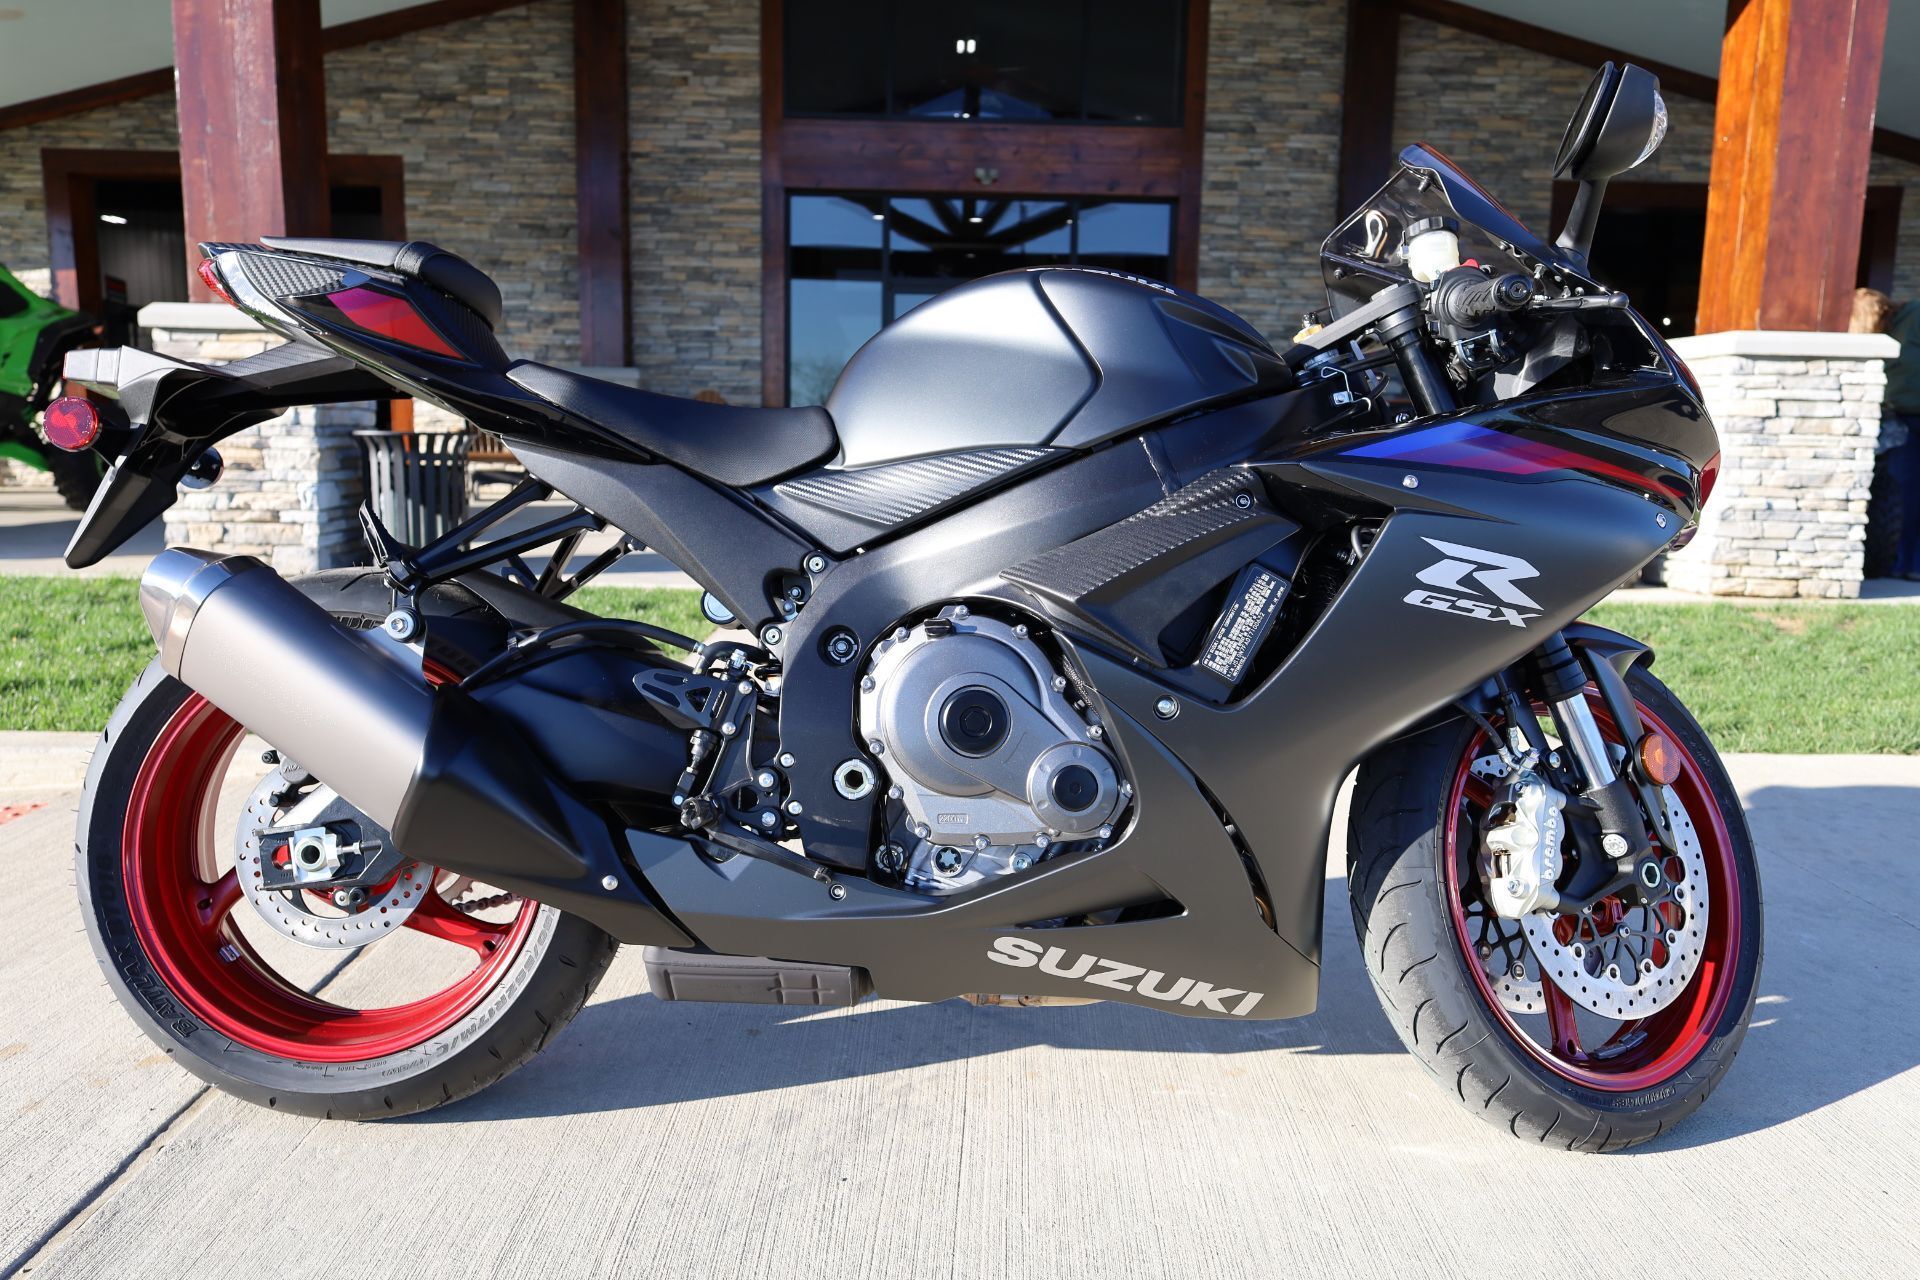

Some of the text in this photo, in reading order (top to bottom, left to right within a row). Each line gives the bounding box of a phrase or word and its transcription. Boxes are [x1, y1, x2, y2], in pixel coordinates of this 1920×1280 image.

[1416, 536, 1545, 611] R
[1541, 806, 1559, 880] brembo
[987, 936, 1264, 1016] SUZUKI
